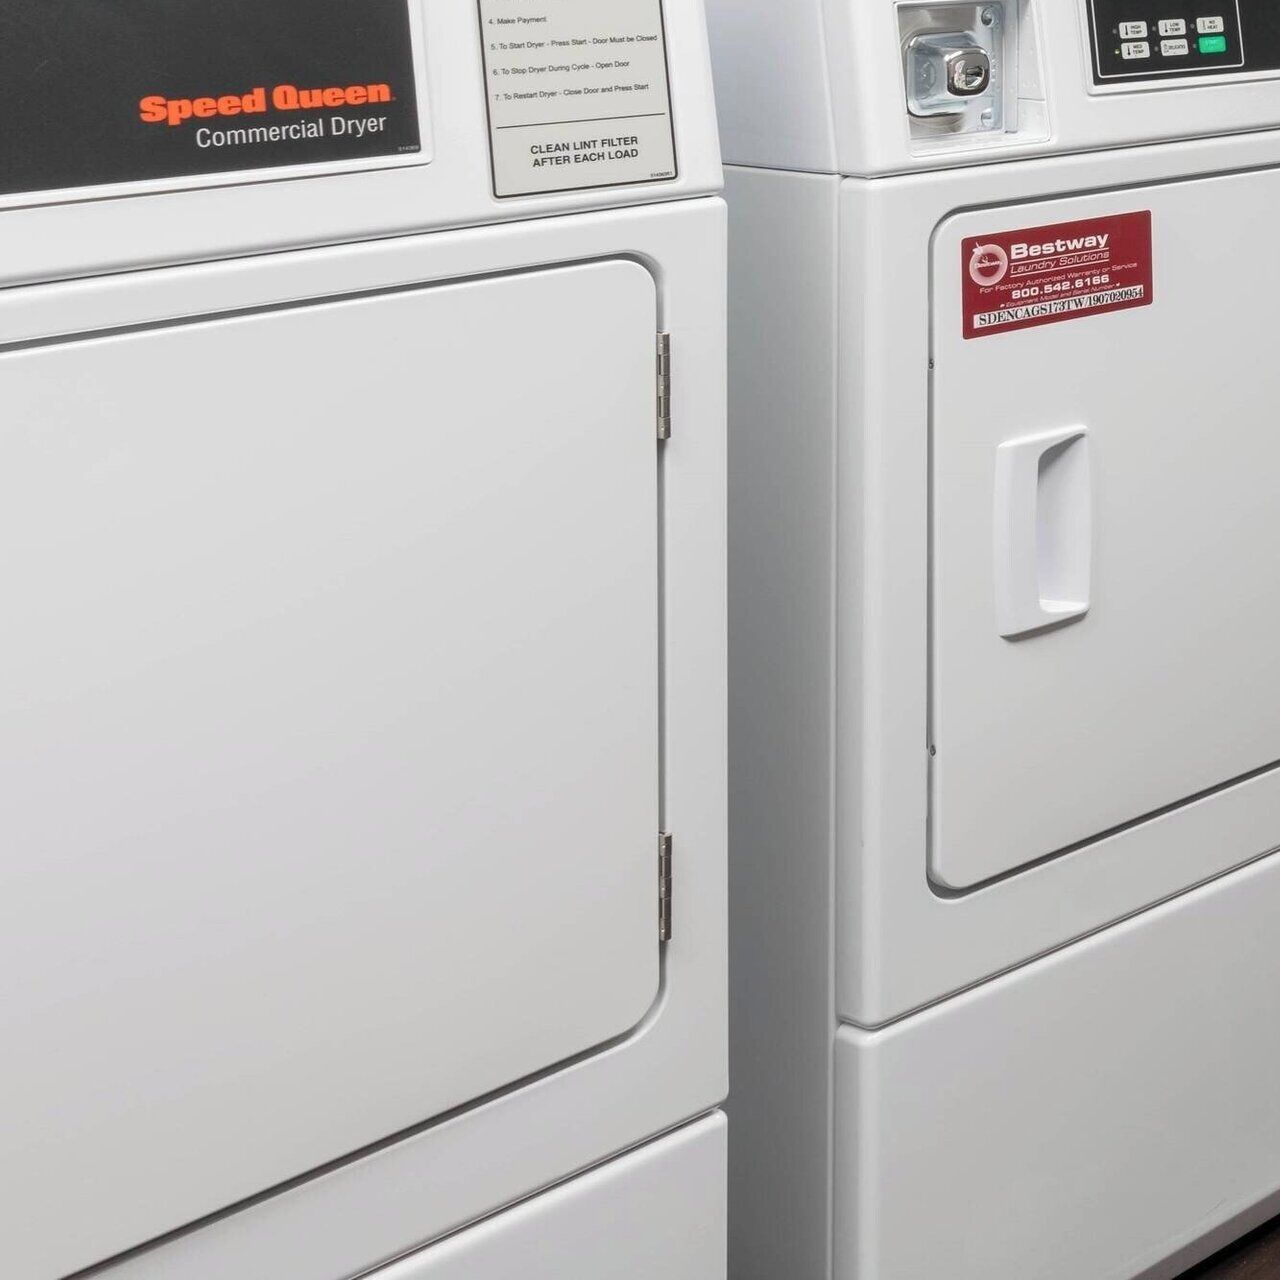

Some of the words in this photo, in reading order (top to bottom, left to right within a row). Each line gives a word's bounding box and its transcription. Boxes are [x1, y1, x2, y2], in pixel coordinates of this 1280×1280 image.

[517, 16, 547, 25] Payment
[509, 42, 525, 50] Start
[526, 41, 544, 50] Dryer
[571, 38, 587, 46] Start
[636, 34, 658, 42] Closed
[511, 67, 526, 76] Stop
[528, 66, 547, 74] Dryer
[548, 64, 570, 73] During
[572, 63, 590, 72] Cycle
[595, 61, 613, 70] Open
[615, 60, 630, 68] Door
[513, 92, 538, 100] Restart
[539, 90, 557, 99] Dryer
[563, 88, 582, 96] Close
[614, 84, 632, 92] Press
[634, 83, 649, 91] Start
[139, 87, 266, 126] Speed
[272, 82, 392, 110] Queen
[196, 120, 324, 148] Commercial
[332, 114, 387, 138] Dryer
[530, 142, 570, 155] CLEAN
[573, 139, 598, 151] LINT
[601, 136, 638, 148] FILTER
[532, 155, 571, 168] AFTER
[574, 152, 605, 164] EACH
[608, 148, 639, 160] LOAD
[1010, 233, 1109, 260] Bestway
[1010, 259, 1056, 274] Laundry
[1059, 251, 1110, 267] Solutions
[996, 283, 1024, 292] Factory
[1026, 275, 1066, 286] Authorized
[1067, 269, 1100, 280] Warranty
[1112, 262, 1138, 271] Service
[1011, 274, 1110, 299] 800.542.6166
